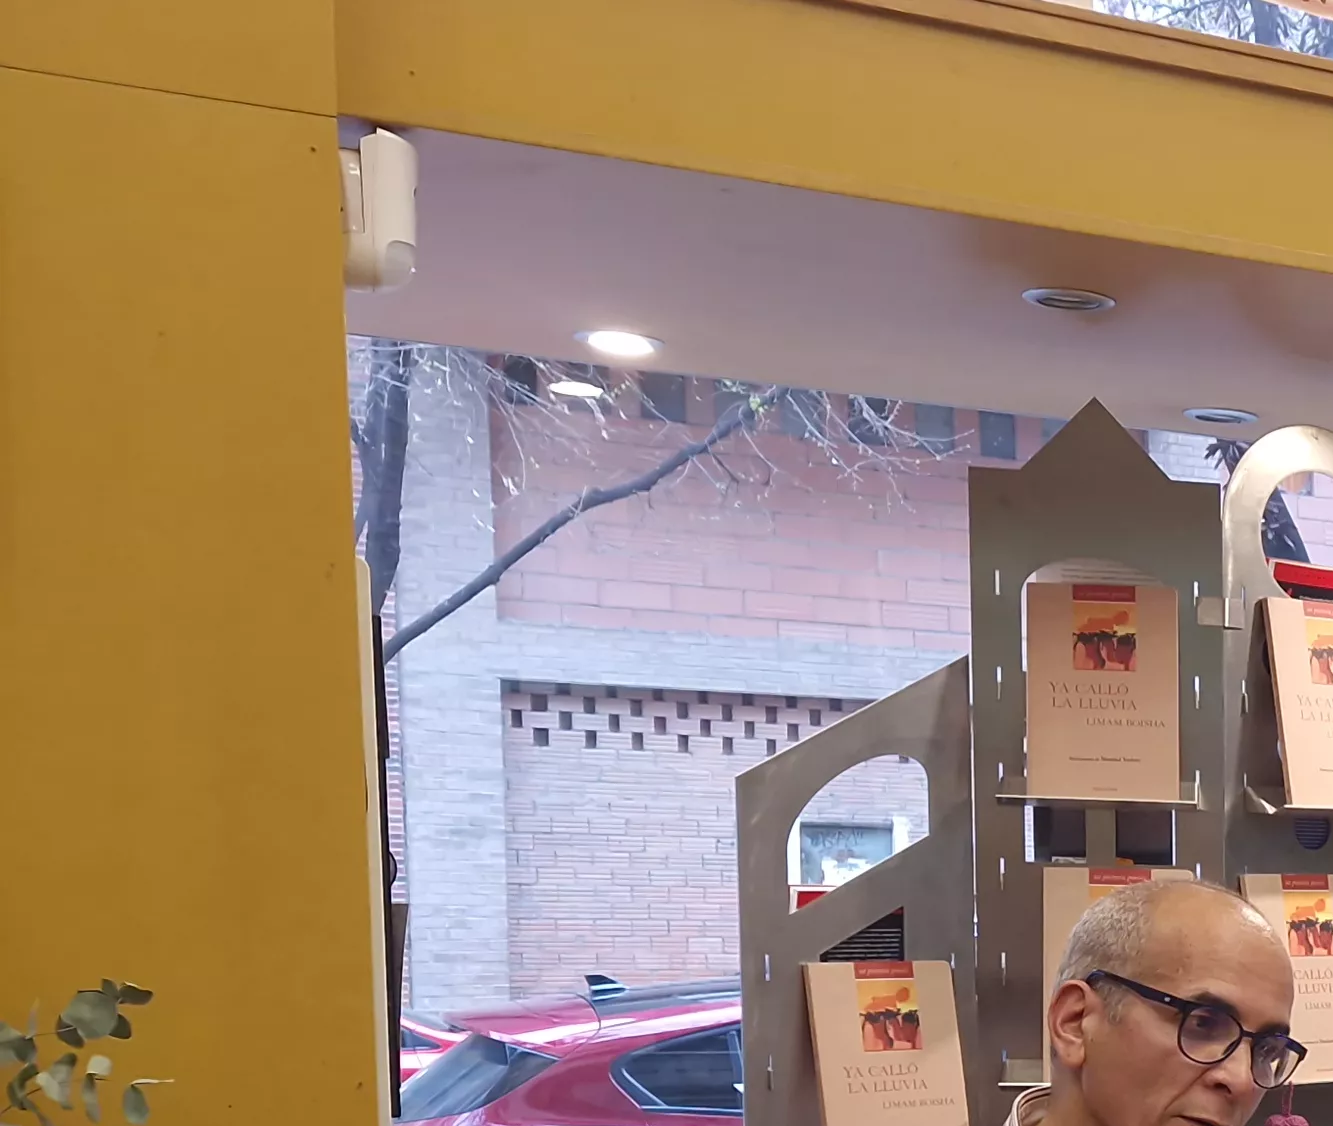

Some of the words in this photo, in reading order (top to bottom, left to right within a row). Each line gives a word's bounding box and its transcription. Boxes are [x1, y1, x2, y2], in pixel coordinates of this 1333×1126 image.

[1050, 681, 1069, 695] YA
[1075, 681, 1129, 696] CALLÓ
[1052, 697, 1073, 709] LA
[1079, 697, 1138, 711] LLUVIA
[843, 1065, 864, 1080] YA
[867, 1062, 919, 1078] CALLÓ
[848, 1081, 868, 1095] LA
[873, 1079, 928, 1093] LLUVIA
